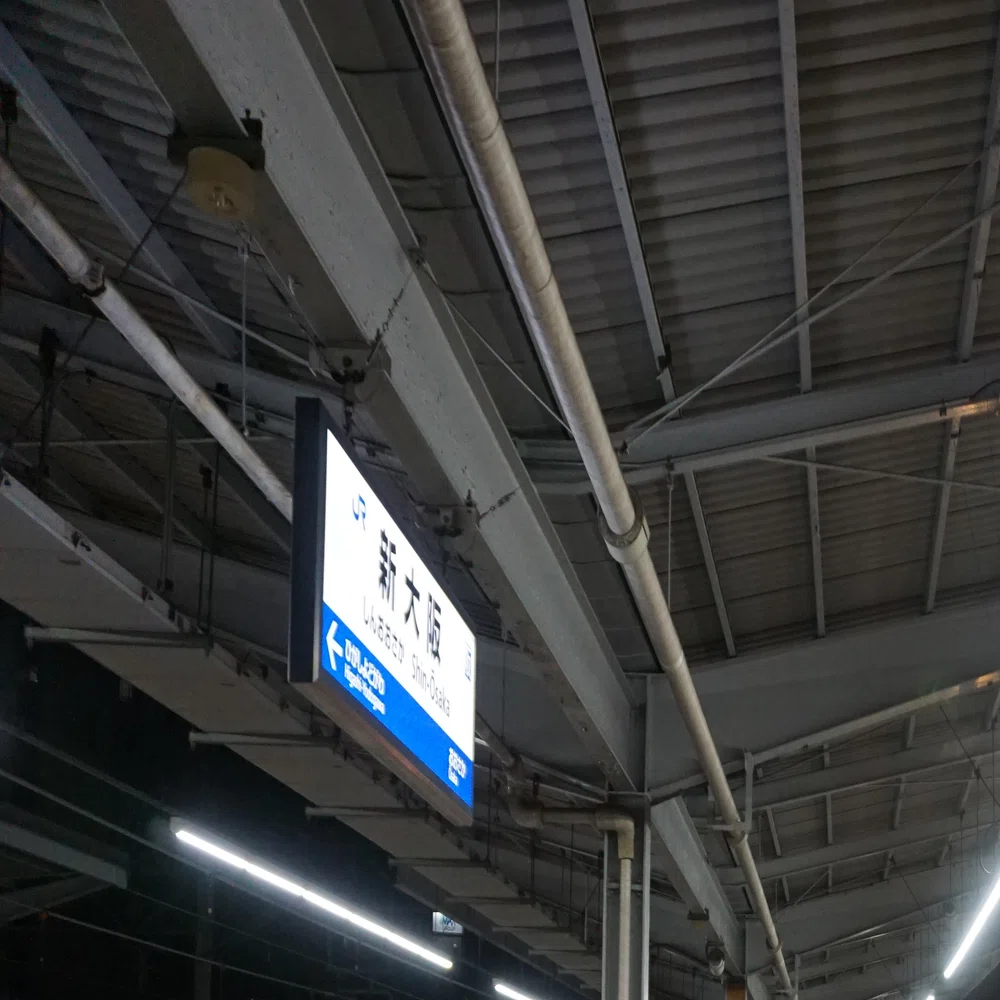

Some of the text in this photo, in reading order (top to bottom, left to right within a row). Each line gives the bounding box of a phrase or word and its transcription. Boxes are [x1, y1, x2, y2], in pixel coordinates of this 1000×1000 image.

[352, 494, 367, 531] JR
[363, 596, 405, 665] しんおおさか
[378, 528, 442, 668] 新大阪
